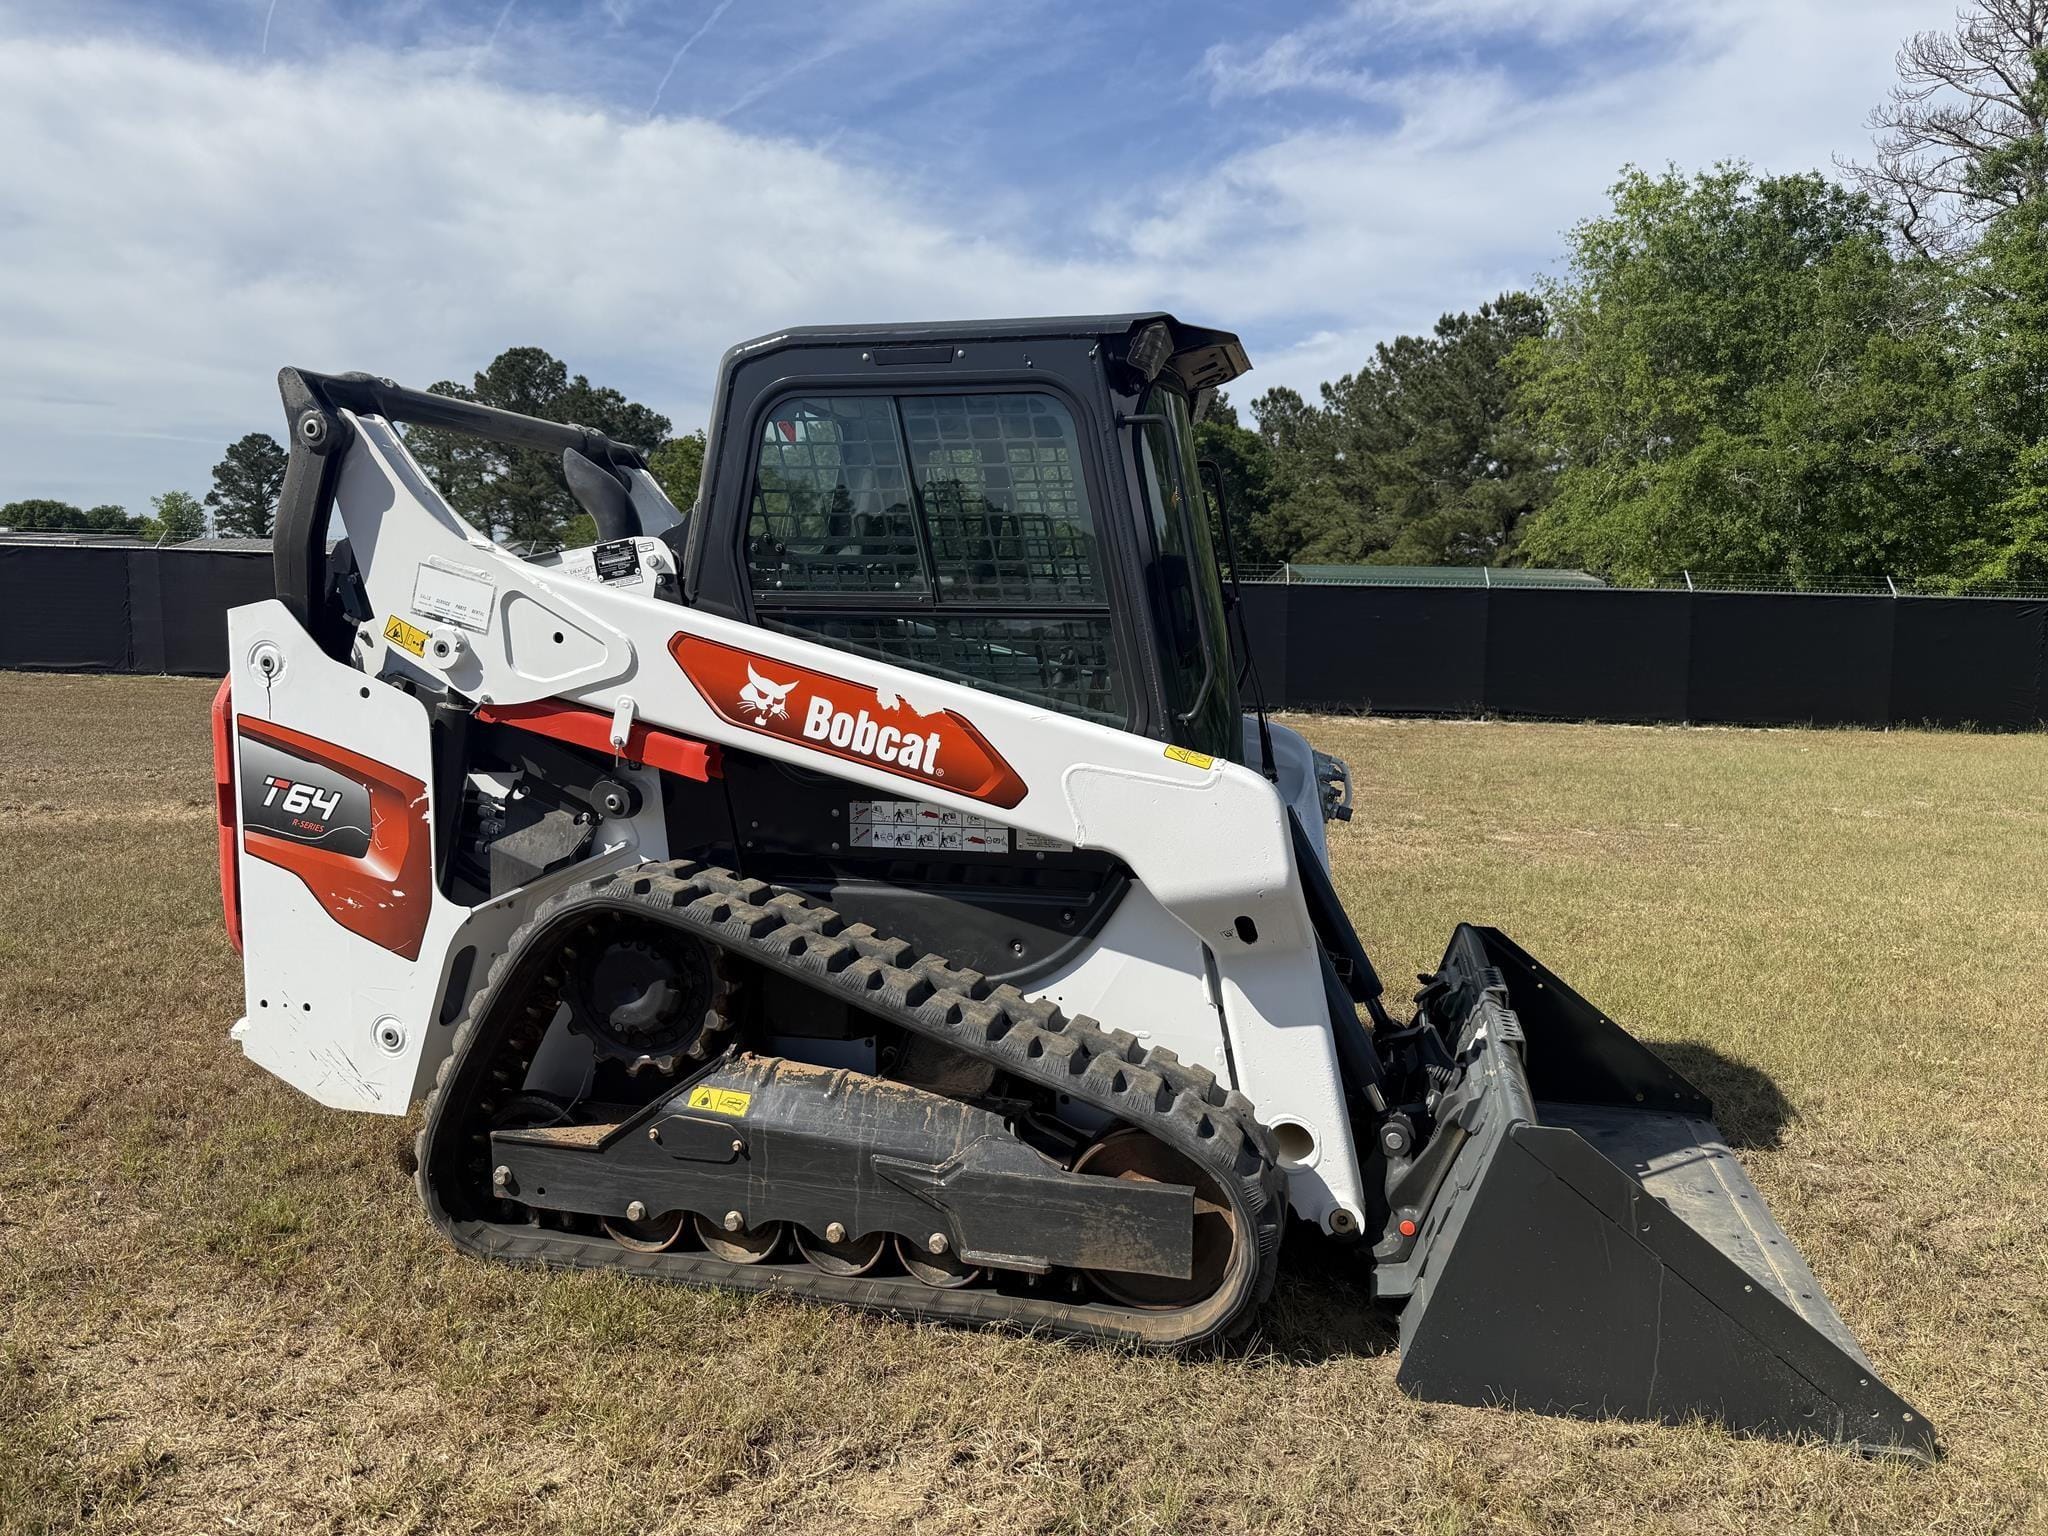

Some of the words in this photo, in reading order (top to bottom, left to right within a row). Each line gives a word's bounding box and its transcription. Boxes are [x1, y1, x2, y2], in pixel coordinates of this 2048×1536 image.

[803, 695, 941, 775] Bobcat
[263, 775, 342, 821] T64
[292, 818, 325, 833] R-SERIES
